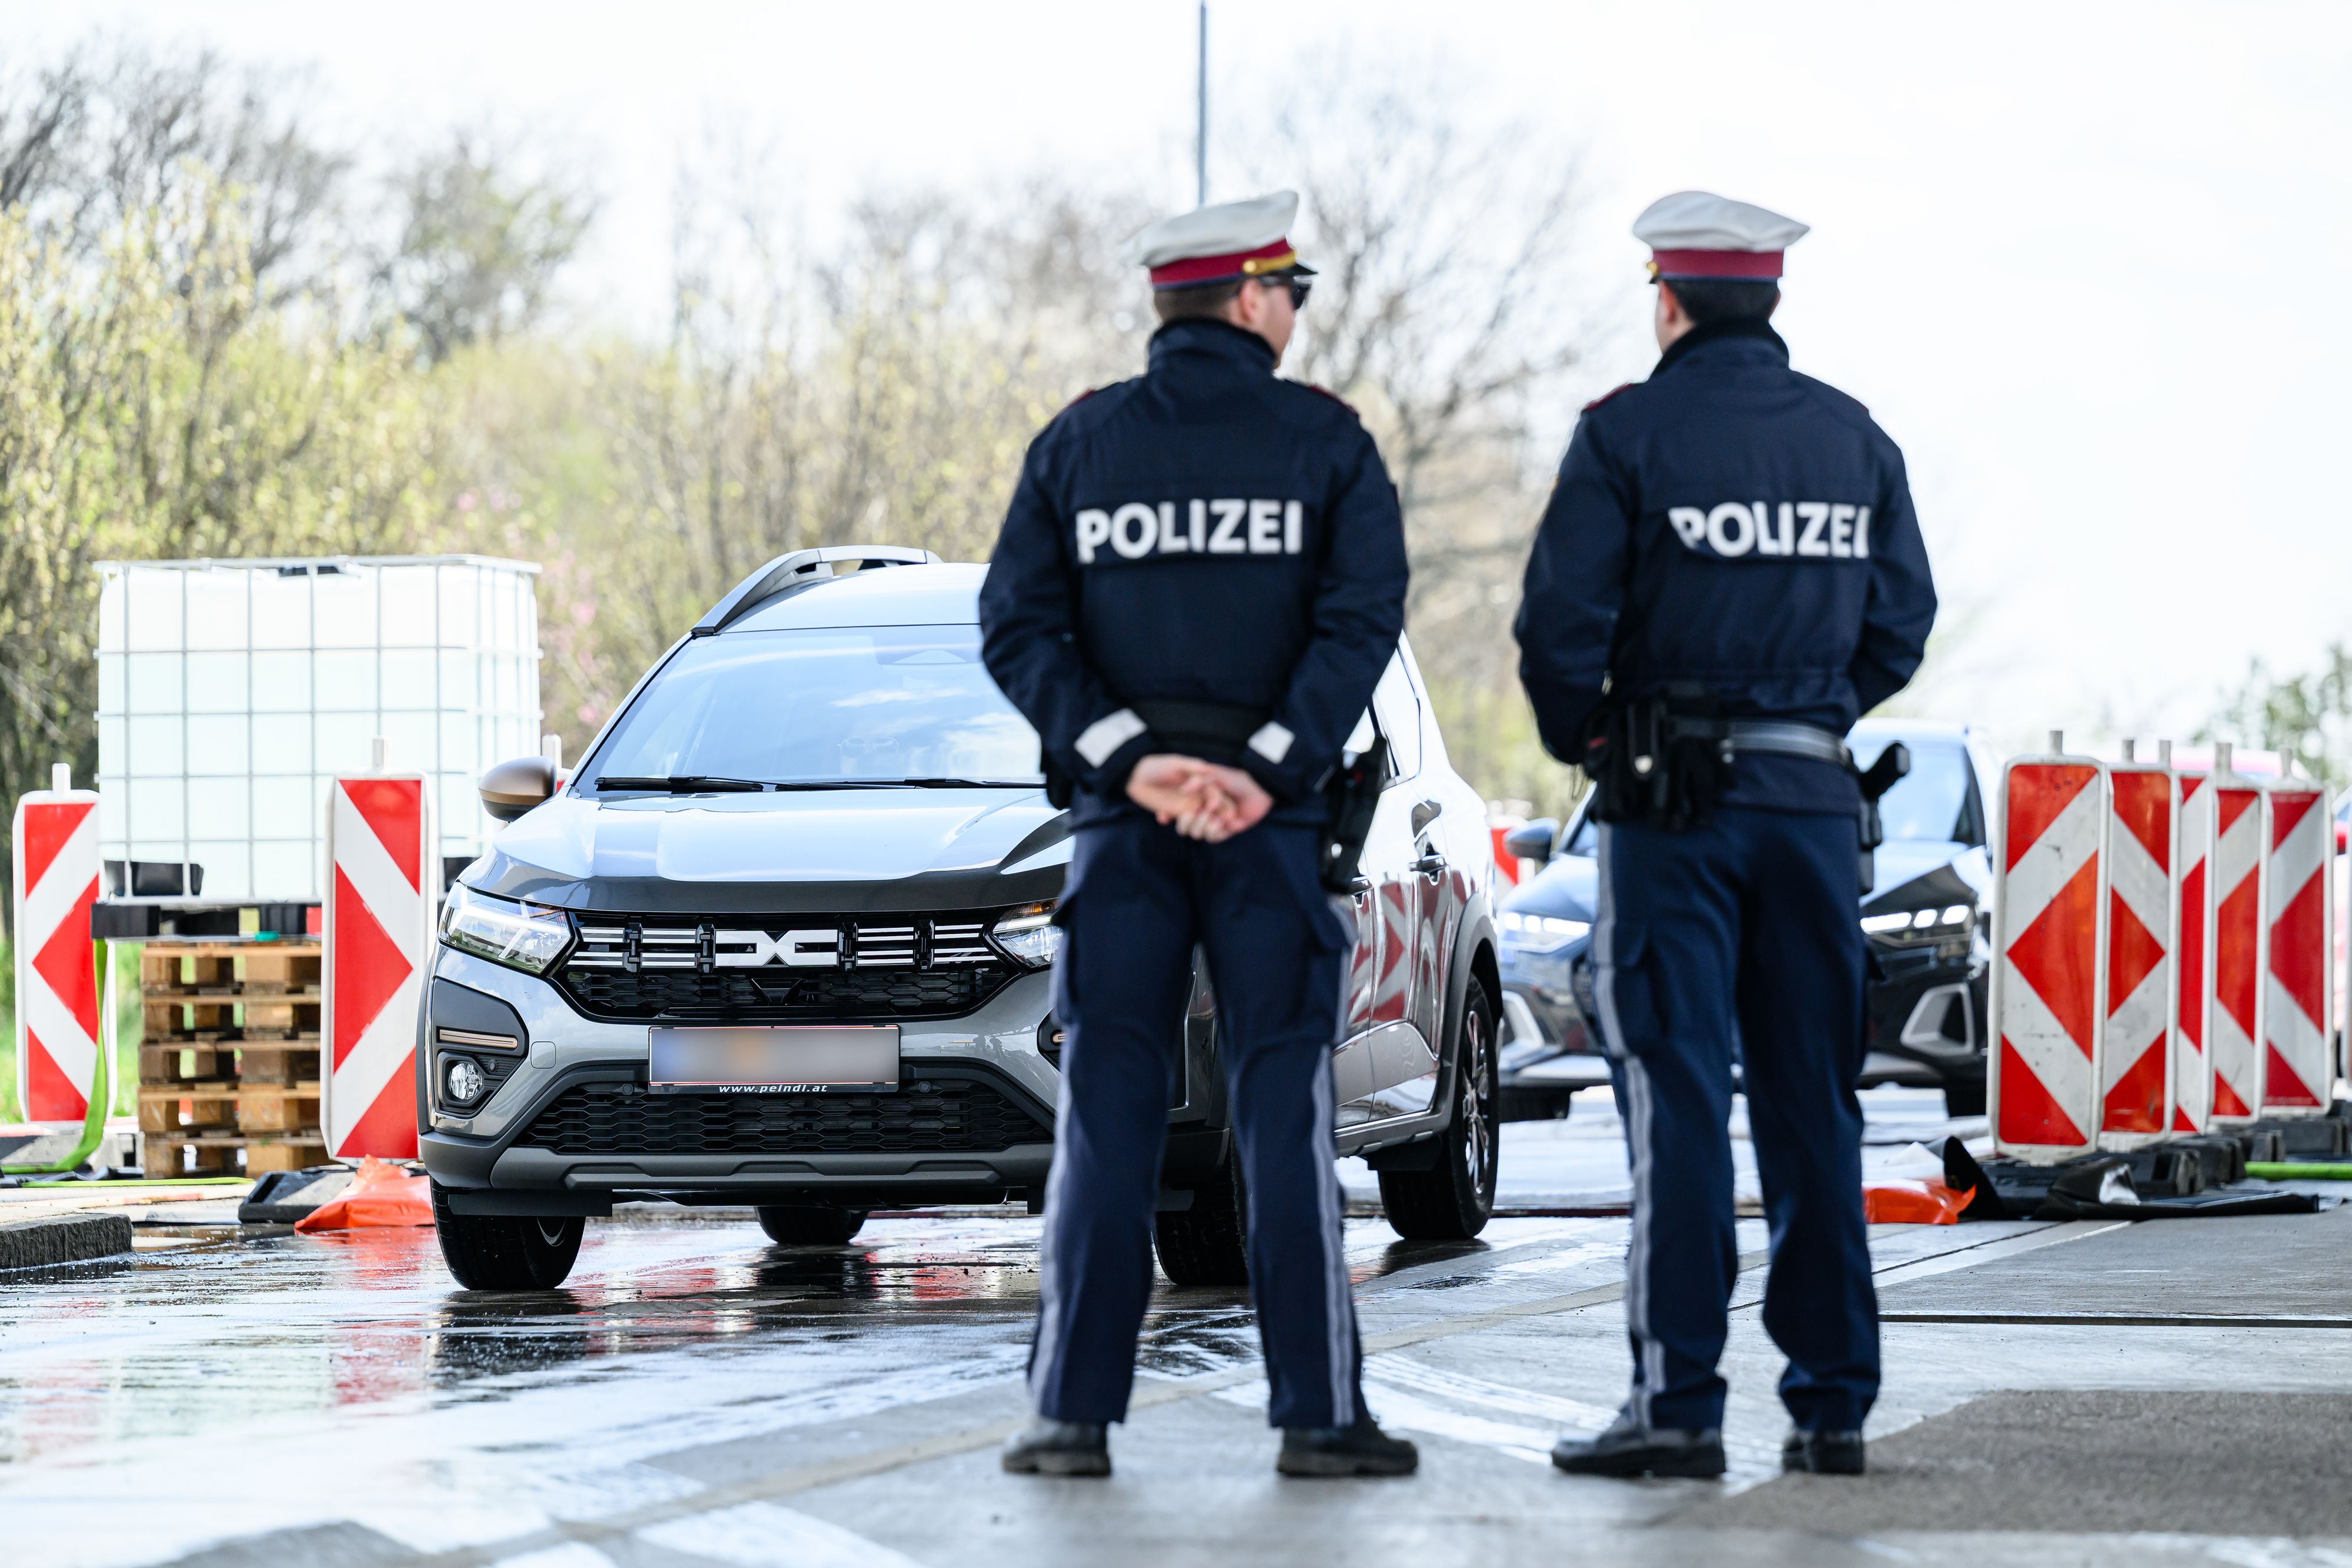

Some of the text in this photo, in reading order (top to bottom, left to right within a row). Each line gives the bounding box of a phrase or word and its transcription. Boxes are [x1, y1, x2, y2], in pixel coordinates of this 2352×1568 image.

[1075, 499, 1302, 564] POLIZEI
[1668, 500, 1871, 559] POLIZEI
[719, 1084, 828, 1094] www.peindl.at
